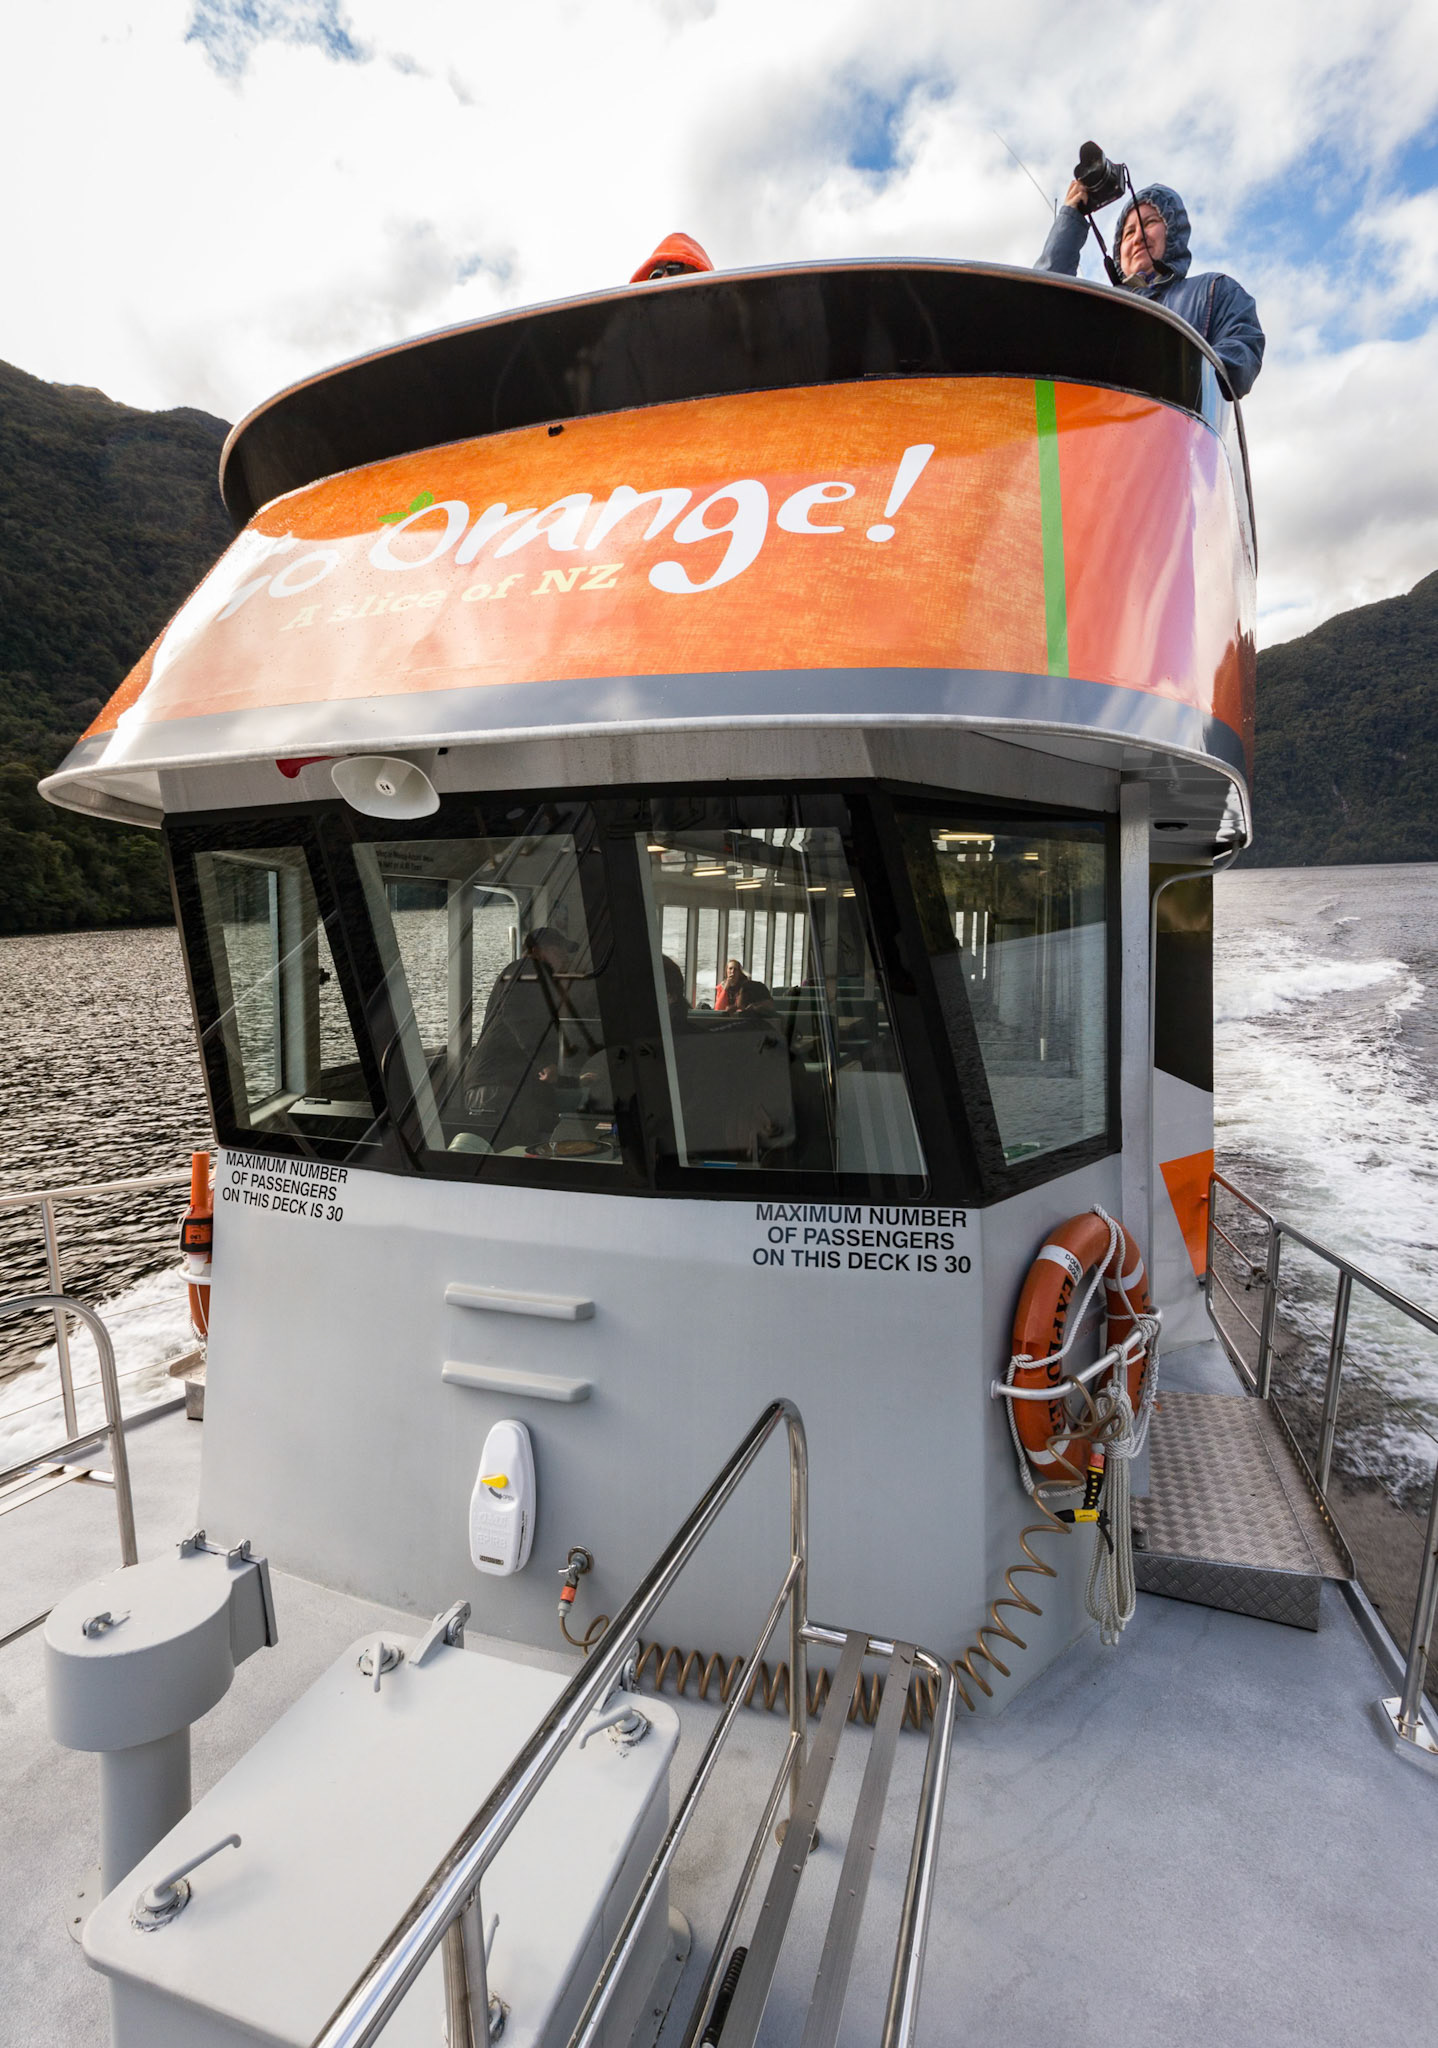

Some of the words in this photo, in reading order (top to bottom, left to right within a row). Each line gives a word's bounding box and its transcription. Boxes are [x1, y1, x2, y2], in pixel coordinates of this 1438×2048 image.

[368, 443, 936, 594] Orange!
[279, 604, 321, 631] A
[327, 589, 448, 623] slice
[461, 573, 525, 602] of
[530, 562, 625, 596] NZ
[226, 1151, 287, 1174] MAXIMUM
[289, 1161, 348, 1184] NUMBER
[231, 1170, 248, 1185] OF
[250, 1173, 337, 1201] PASSENGERS
[222, 1187, 240, 1202] ON
[243, 1190, 269, 1208] THIS
[272, 1196, 307, 1216] DECK
[310, 1203, 324, 1218] IS
[326, 1206, 344, 1222] 30
[755, 1203, 862, 1224] MAXIMUM
[869, 1207, 967, 1228] NUMBER
[767, 1226, 797, 1244] OF
[803, 1227, 955, 1250] PASSENGERS
[752, 1247, 785, 1266] ON
[791, 1249, 841, 1269] THIS
[848, 1251, 911, 1272] DECK
[917, 1254, 938, 1273] IS
[944, 1255, 972, 1274] 30
